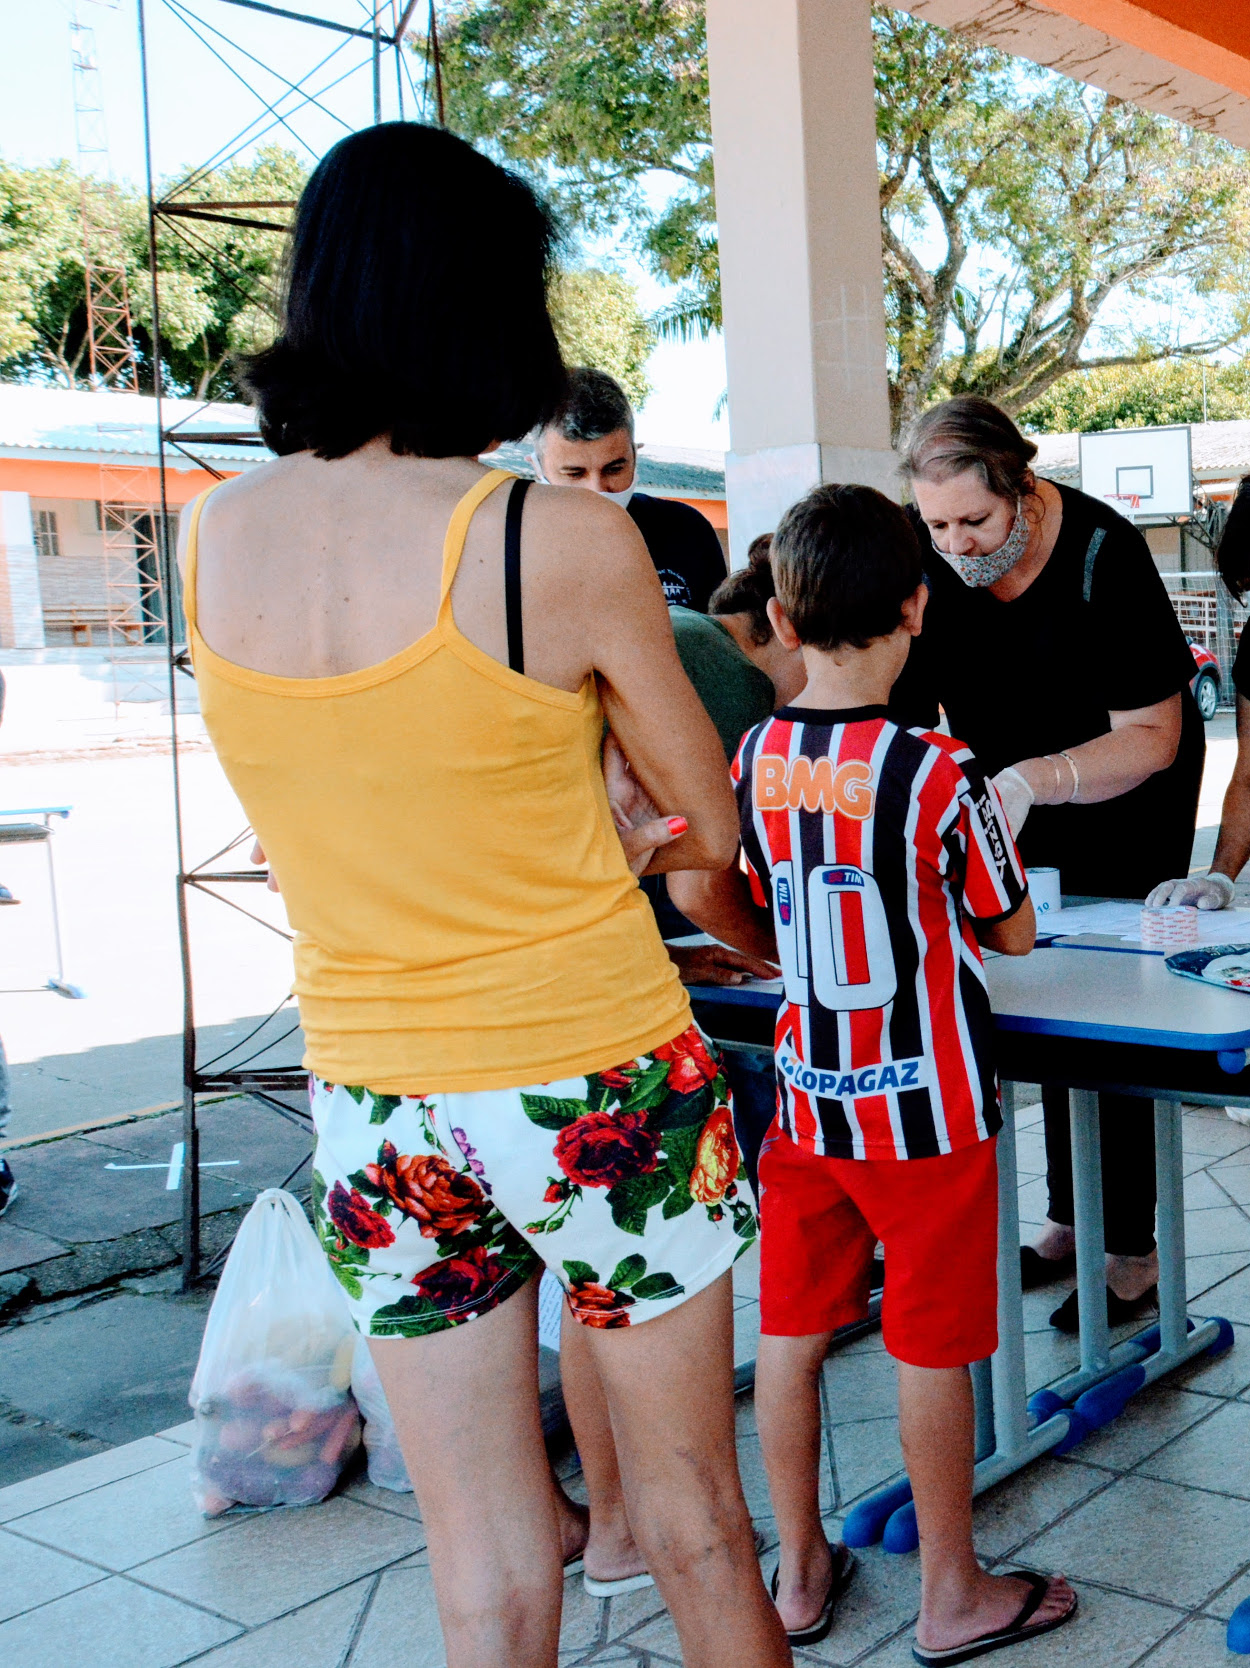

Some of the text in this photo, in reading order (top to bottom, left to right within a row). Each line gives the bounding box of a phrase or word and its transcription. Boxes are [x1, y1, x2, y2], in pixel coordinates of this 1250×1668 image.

[753, 754, 876, 820] BMG
[844, 871, 862, 885] TIM
[778, 882, 789, 904] TIM
[1037, 902, 1050, 913] 10
[770, 859, 899, 1012] 10
